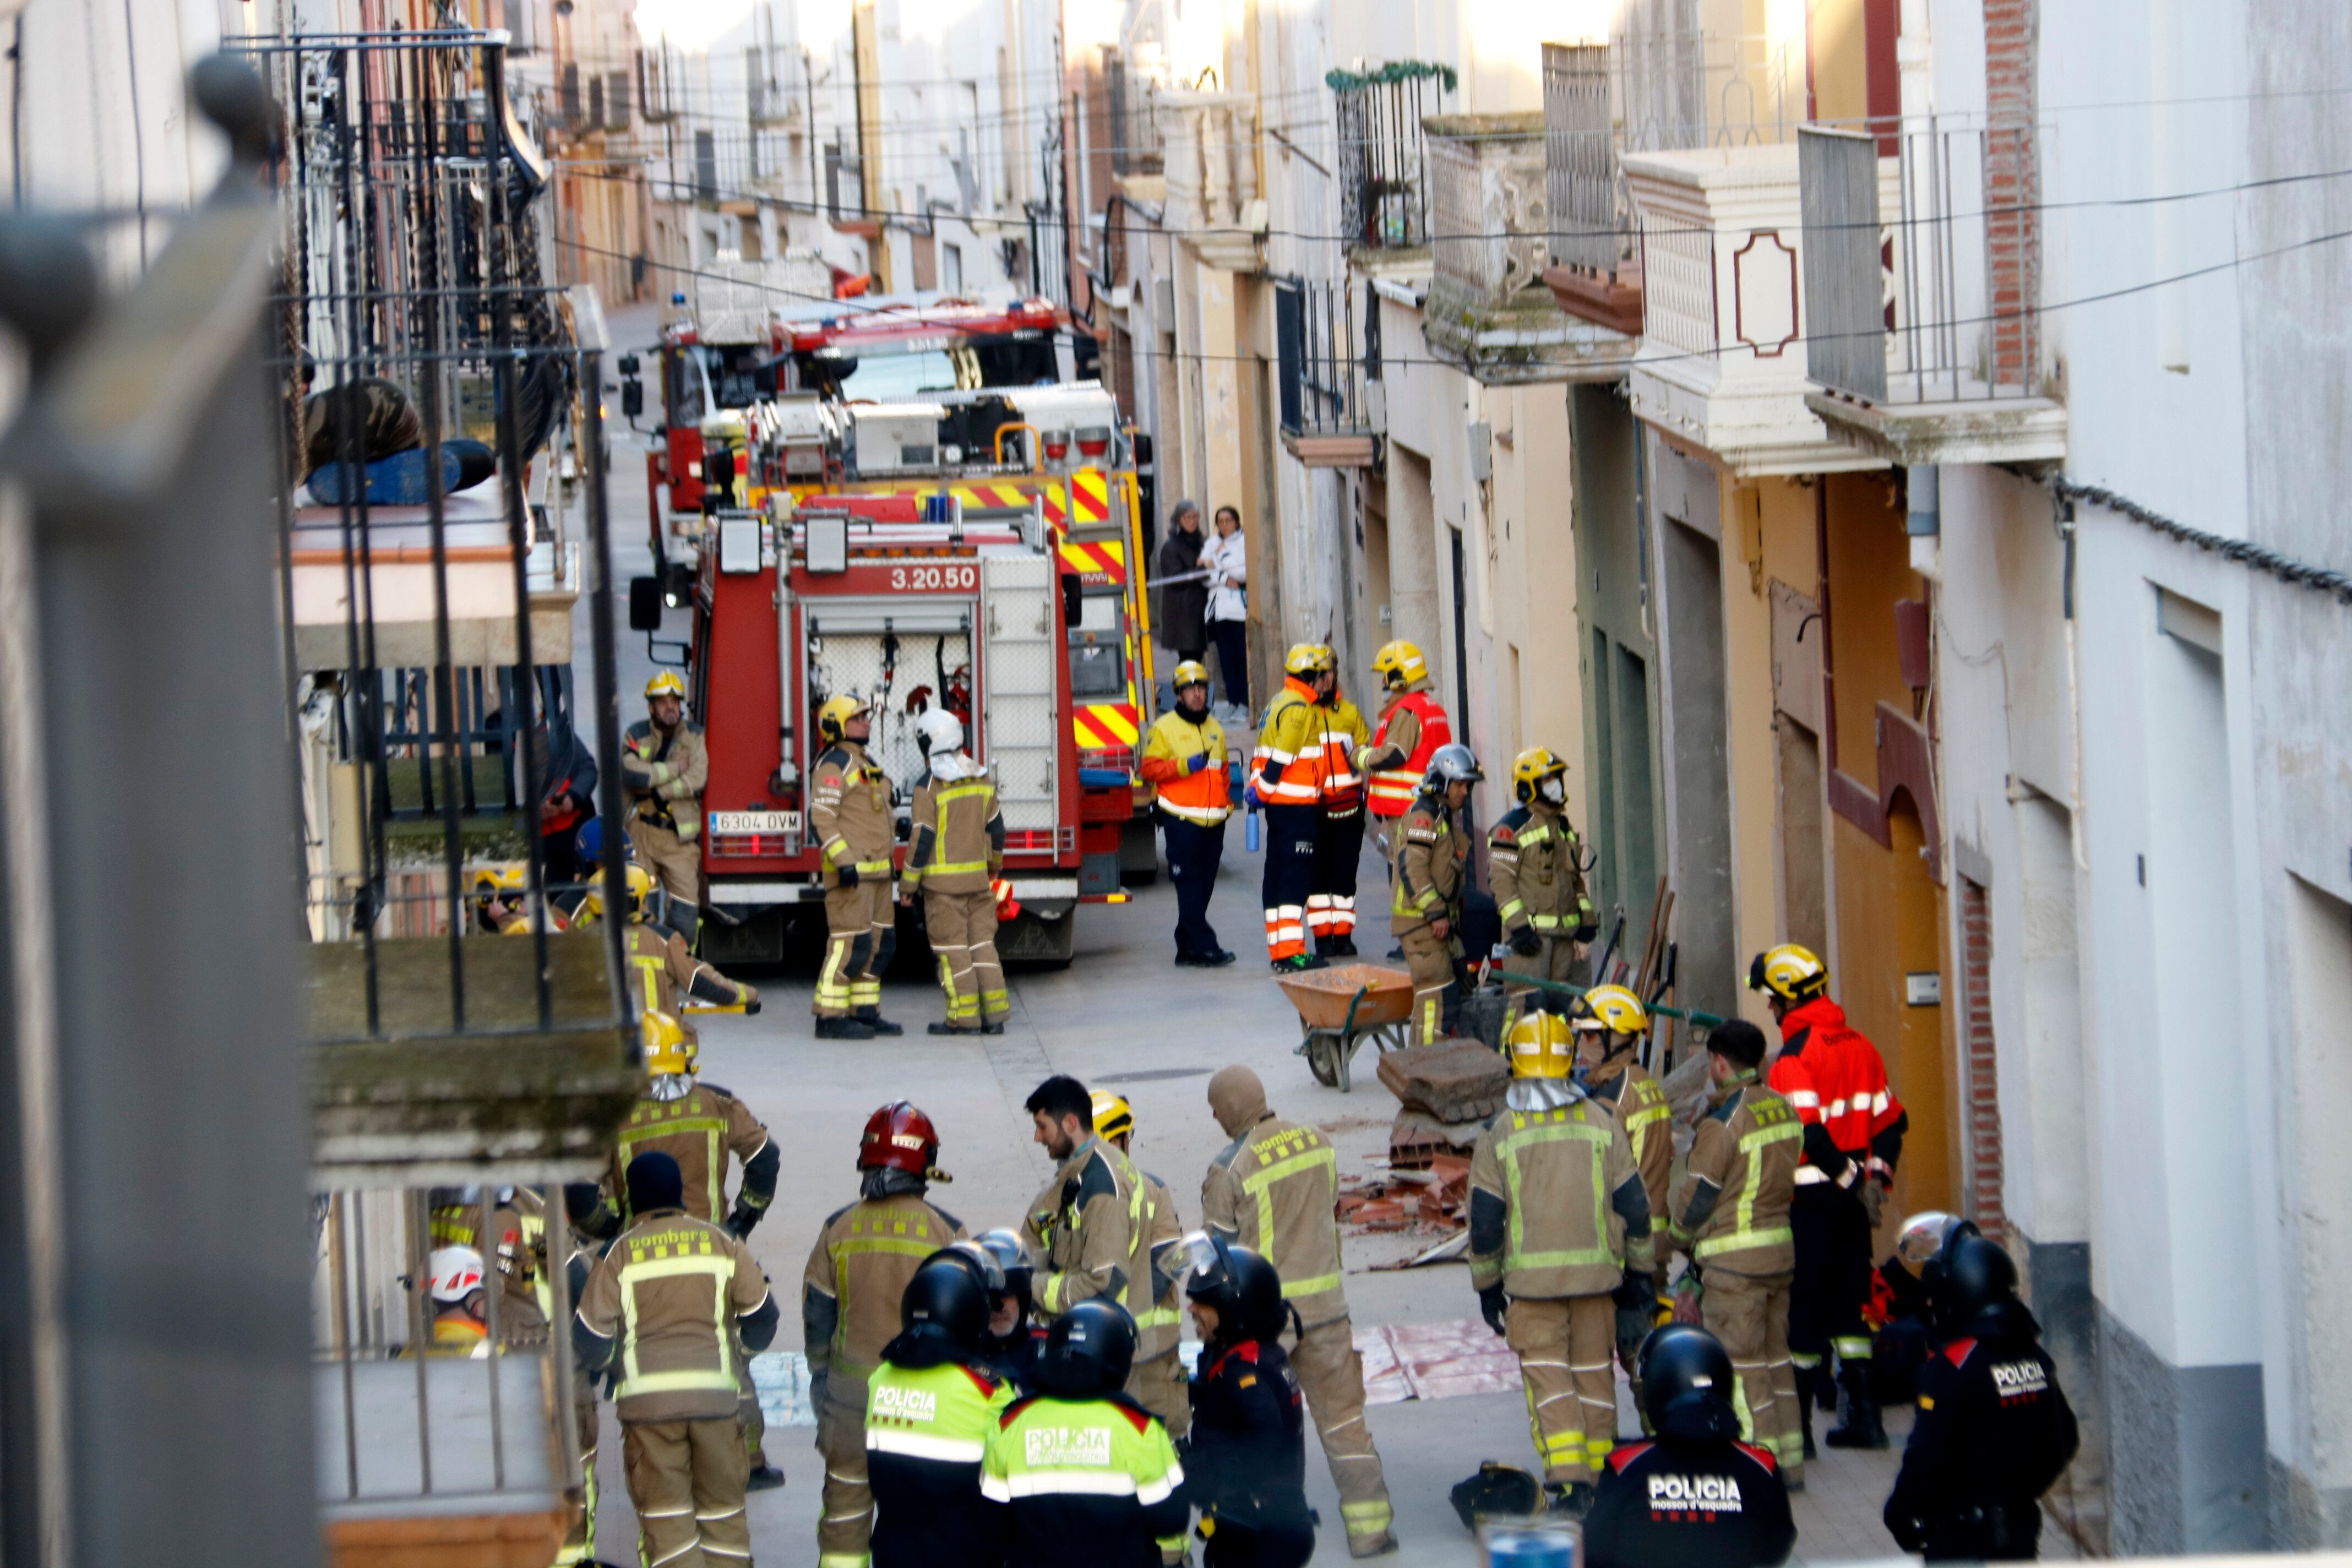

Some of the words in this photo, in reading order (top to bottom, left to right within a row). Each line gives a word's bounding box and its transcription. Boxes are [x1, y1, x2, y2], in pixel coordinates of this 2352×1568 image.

[891, 567, 975, 590] 3.20.50
[721, 815, 760, 829] 6304
[767, 814, 798, 829] DVM
[629, 1228, 710, 1250] bombers
[1990, 1362, 2046, 1387] POLICIA
[874, 1386, 936, 1412] POLICIA
[1648, 1473, 1741, 1501] POLICIA
[1651, 1499, 1689, 1511] mossos
[1689, 1499, 1743, 1513] d'esquadra
